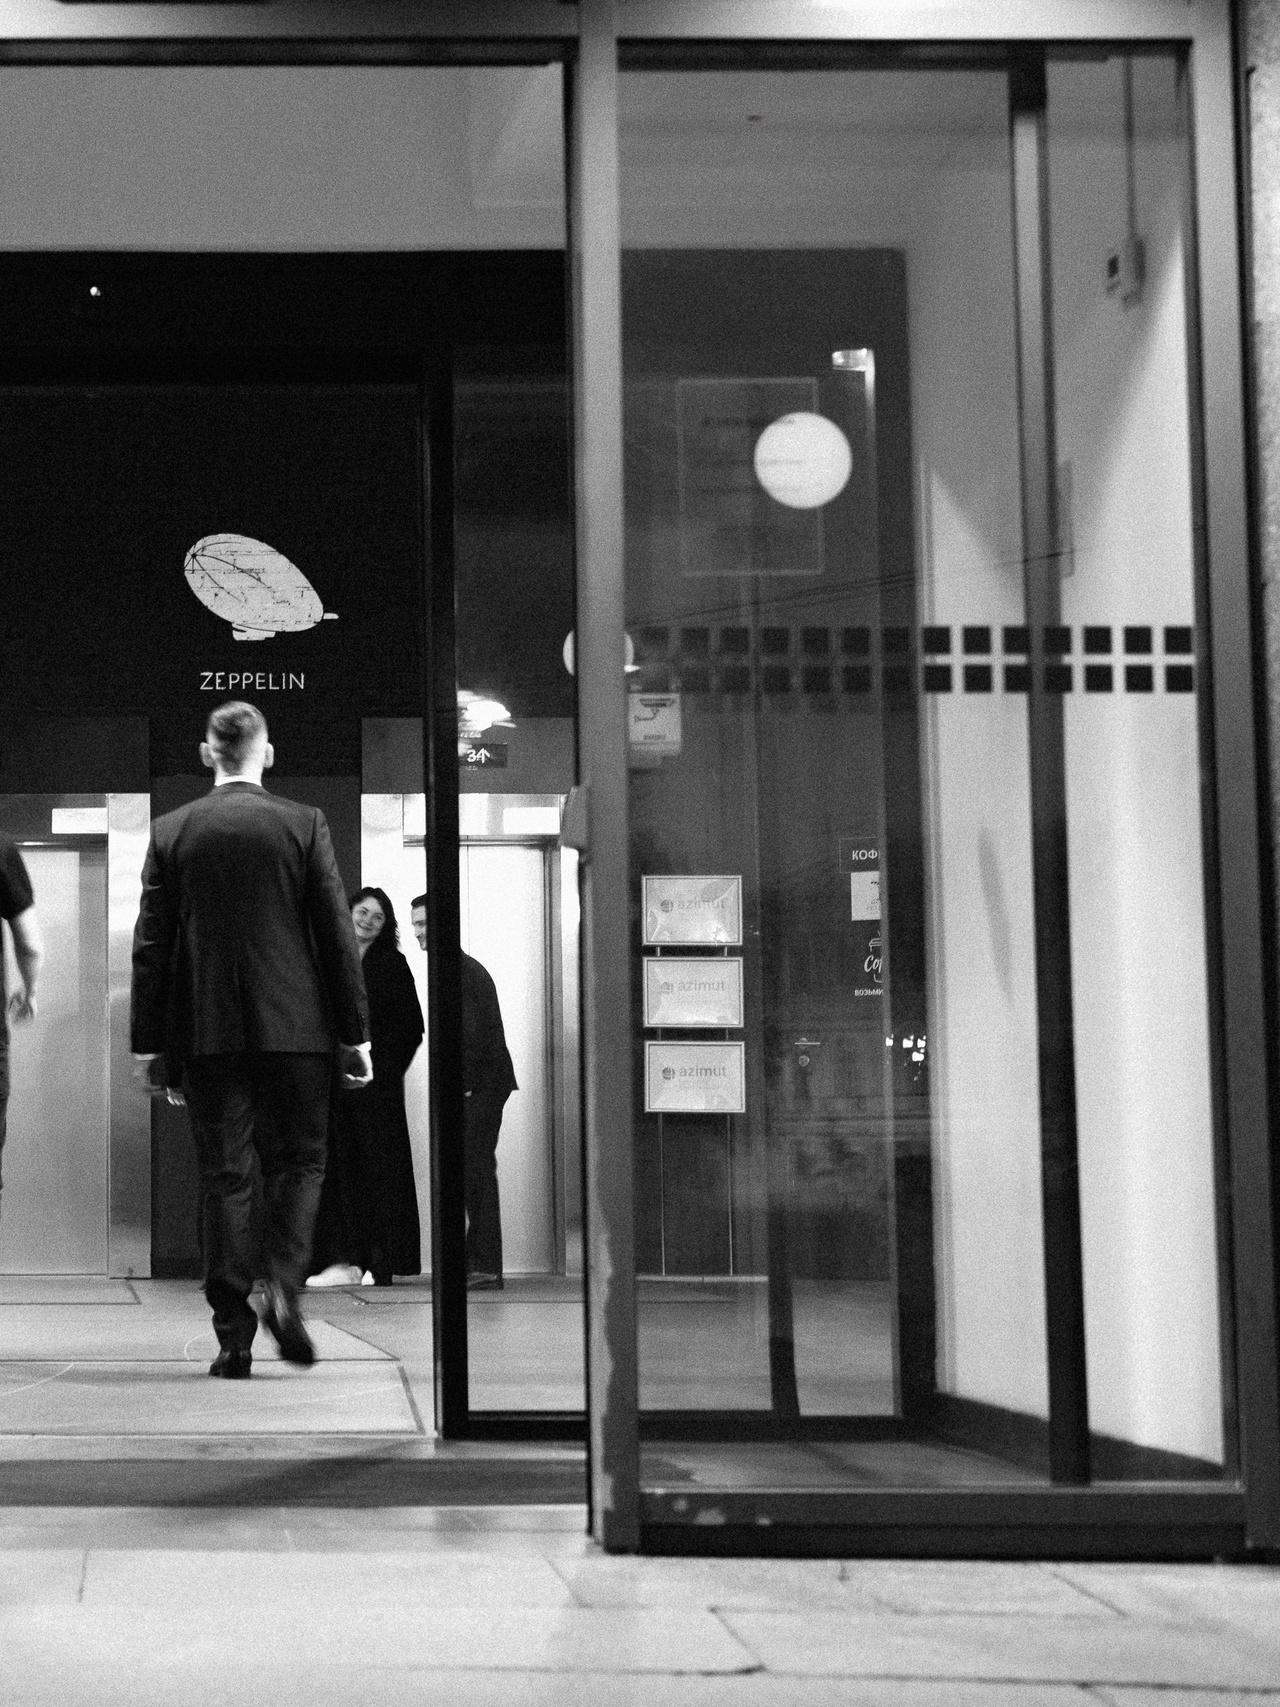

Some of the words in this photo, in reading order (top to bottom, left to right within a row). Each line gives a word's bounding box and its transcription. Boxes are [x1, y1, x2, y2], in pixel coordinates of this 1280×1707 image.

[200, 672, 305, 690] ZEPPELIN
[852, 849, 880, 860] КОФ
[680, 1065, 727, 1077] azimut
